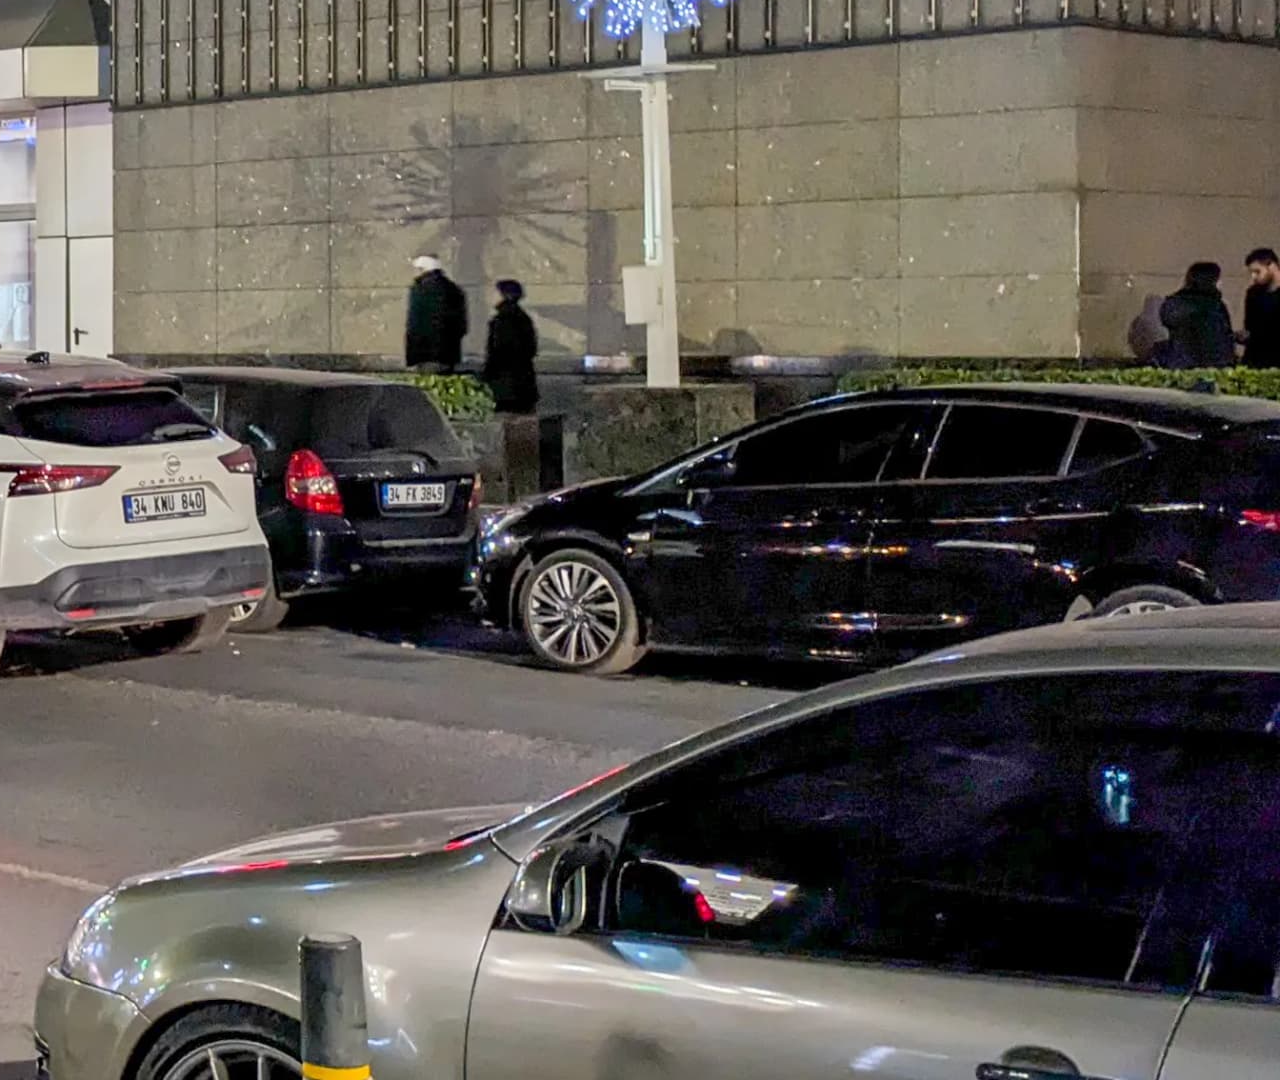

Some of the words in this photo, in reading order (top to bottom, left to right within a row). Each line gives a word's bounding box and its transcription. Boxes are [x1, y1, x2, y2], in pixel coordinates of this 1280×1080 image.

[133, 497, 147, 515] 34
[181, 492, 202, 510] 840
[389, 487, 400, 502] 34
[420, 486, 443, 501] 3849
